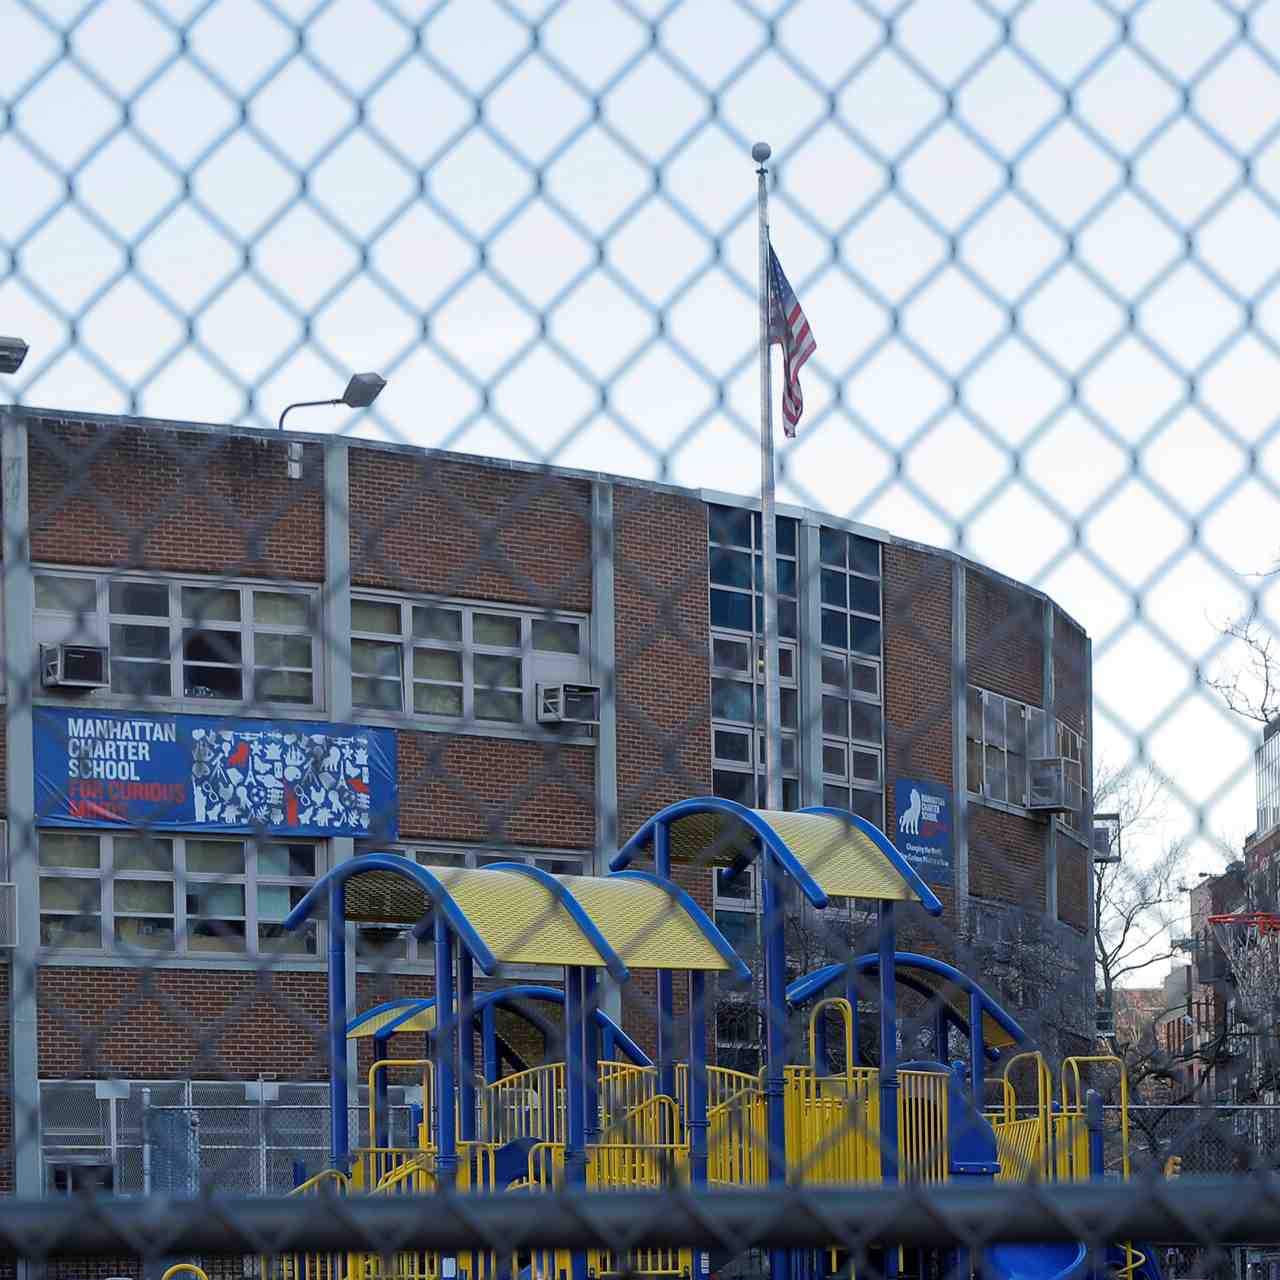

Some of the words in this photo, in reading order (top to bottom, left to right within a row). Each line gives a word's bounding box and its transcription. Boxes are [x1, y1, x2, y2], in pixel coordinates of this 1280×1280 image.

[67, 718, 176, 742] MANHATTAN
[67, 738, 150, 761] CHARTER
[68, 759, 140, 781] SCHOOL
[107, 781, 185, 803] CURIOUS
